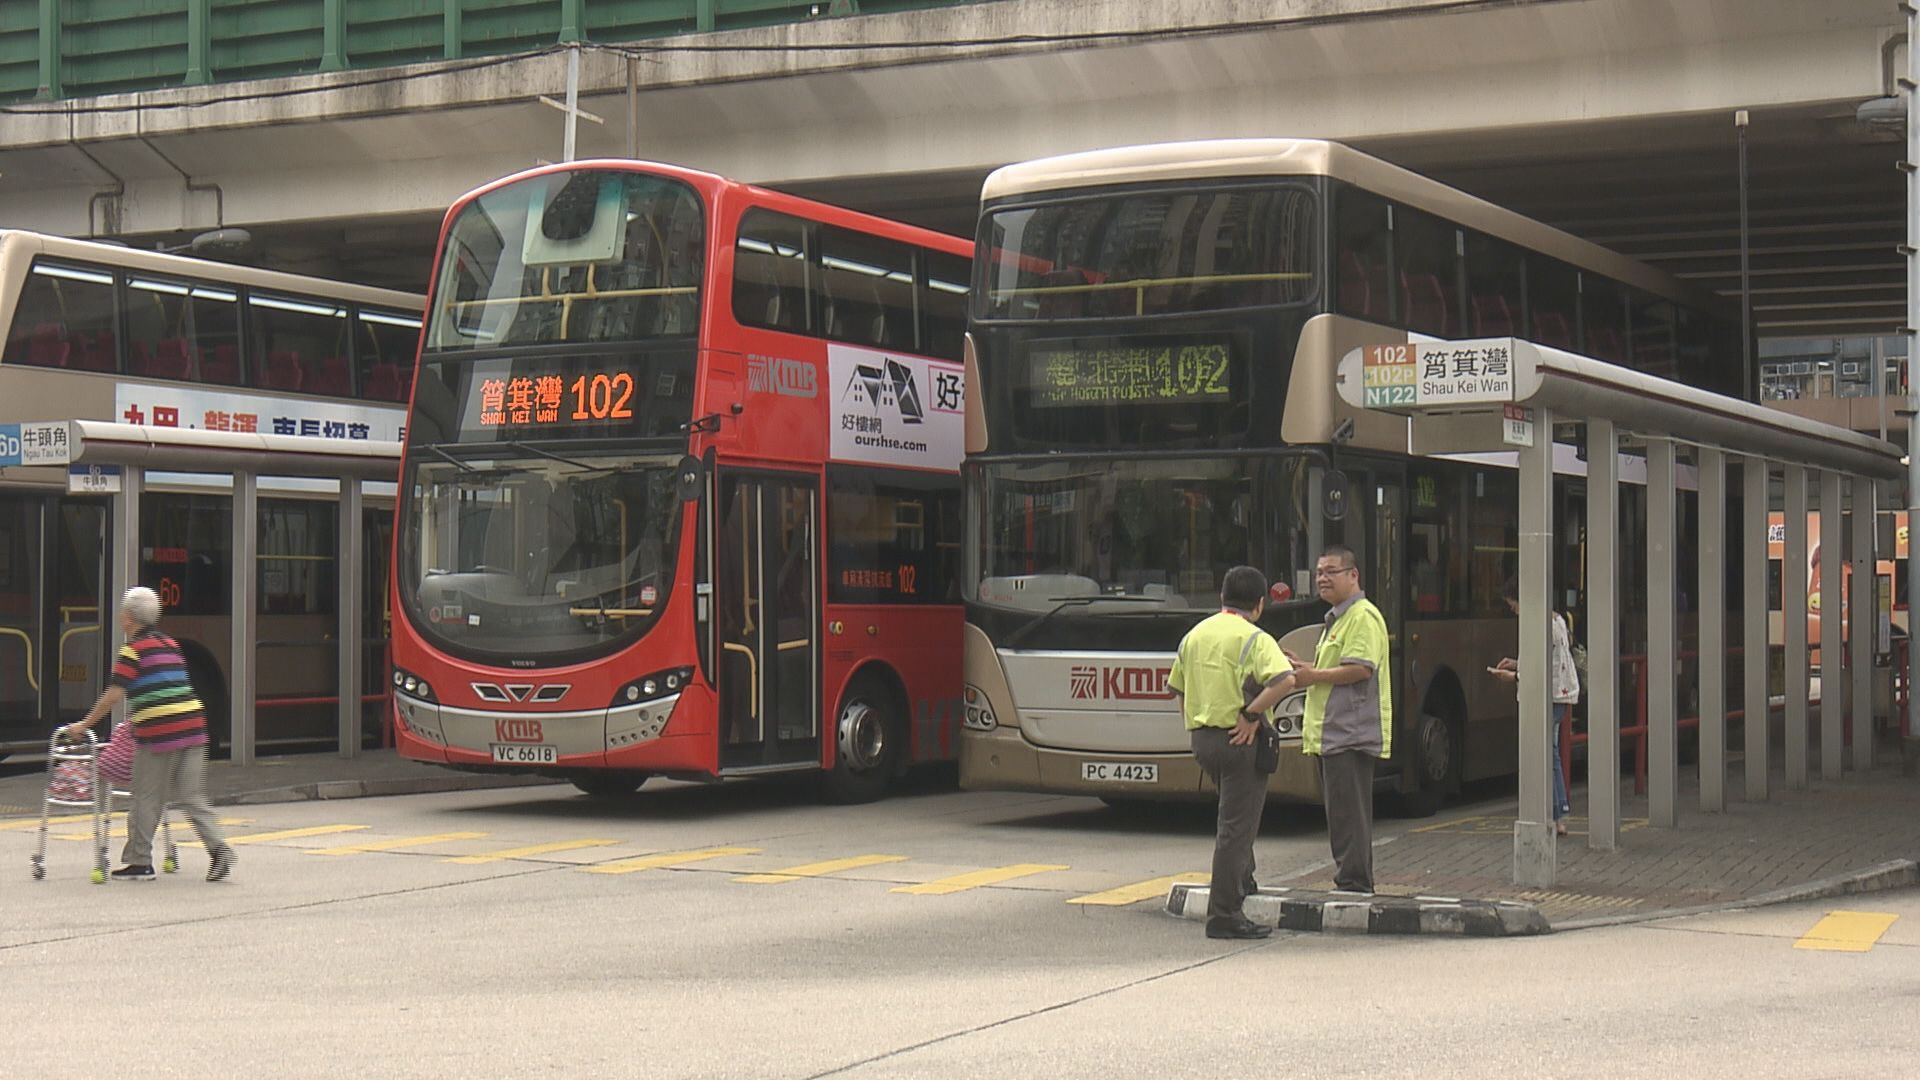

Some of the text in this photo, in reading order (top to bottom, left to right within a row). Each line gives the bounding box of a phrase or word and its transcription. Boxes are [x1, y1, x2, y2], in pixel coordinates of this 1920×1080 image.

[1374, 346, 1407, 364] 102
[1423, 347, 1509, 380] 筲箕灣
[767, 356, 818, 399] KMB
[1156, 345, 1229, 397] 102
[1371, 366, 1414, 384] 102P
[480, 373, 634, 420] 筲箕灣 102
[936, 372, 965, 410] 好
[1367, 386, 1415, 405] N122
[1423, 380, 1509, 396] Shau Kei Wan
[480, 409, 558, 425] SHAU KEI WAN
[0, 434, 20, 457] 6D
[23, 427, 68, 448] 牛頭角
[855, 434, 927, 452] ourshse.com
[24, 447, 67, 461] Ngau Tau Kok
[898, 565, 916, 593] 102
[495, 719, 544, 743] KMB
[498, 747, 552, 761] VC 6618
[1087, 764, 1154, 780] PC 4423
